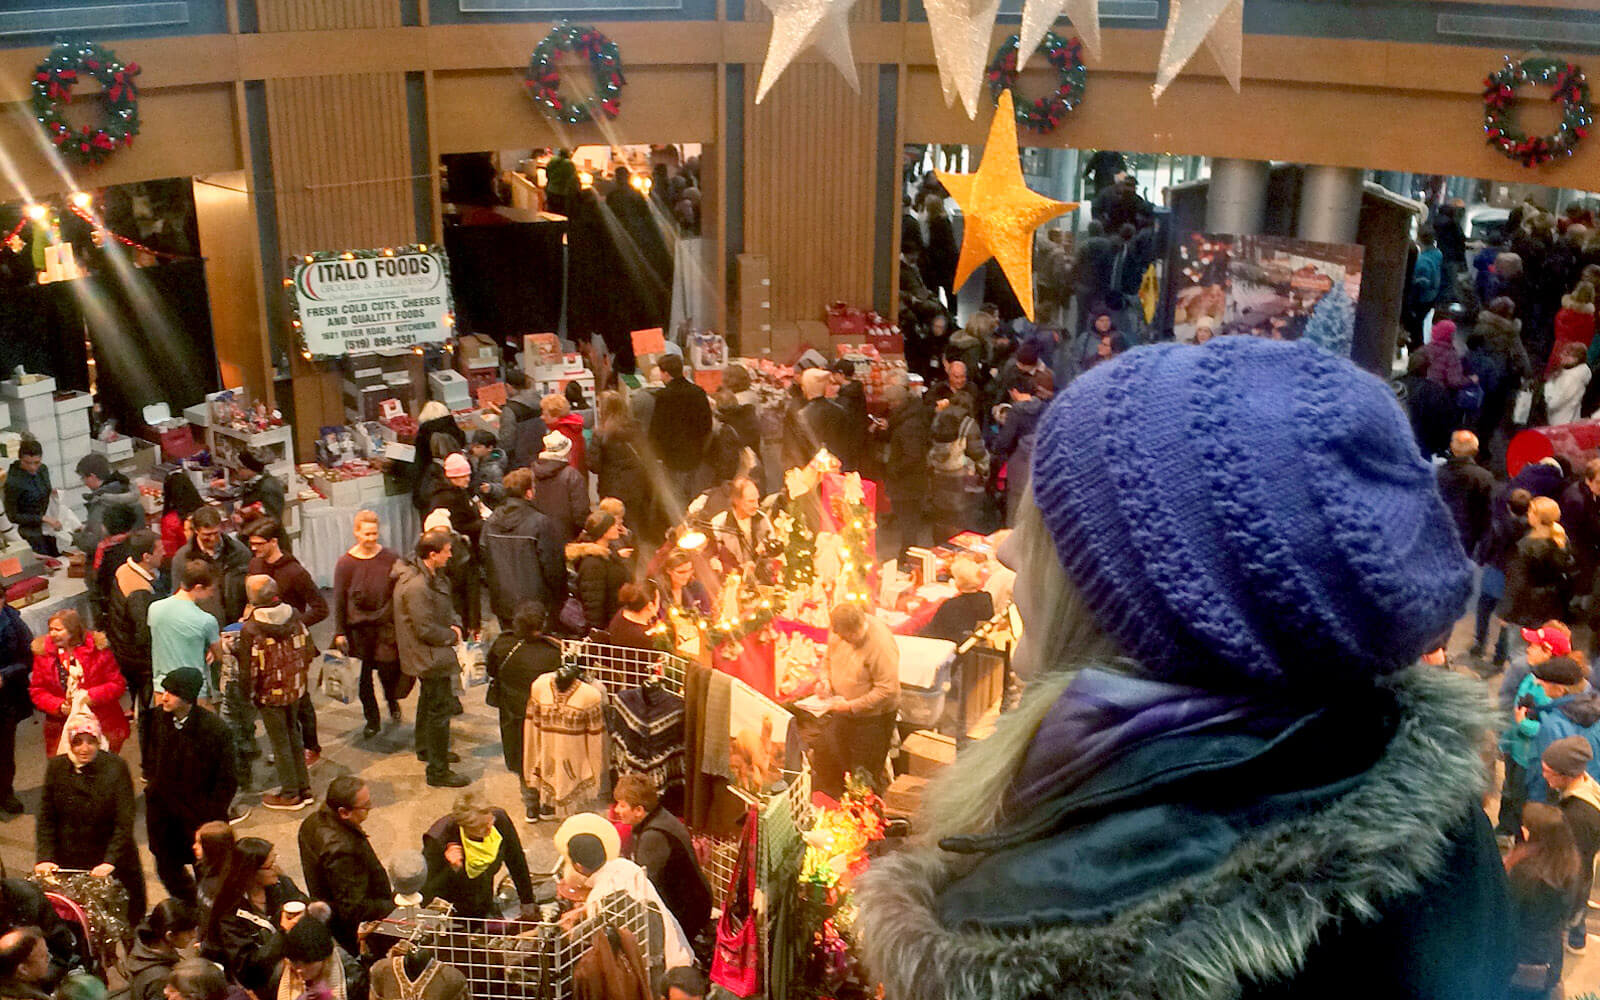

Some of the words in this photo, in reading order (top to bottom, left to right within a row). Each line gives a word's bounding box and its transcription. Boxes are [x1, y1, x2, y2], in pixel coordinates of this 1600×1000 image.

[318, 262, 368, 283] ITALO
[375, 257, 430, 278] FOODS
[306, 306, 338, 317] FRESH
[341, 303, 368, 314] COLD
[402, 297, 441, 308] CHEESES
[327, 316, 347, 327] AND
[351, 312, 392, 324] QUALITY
[396, 309, 425, 320] FOODS
[341, 328, 364, 338] RIVER
[366, 327, 386, 336] ROAD
[395, 321, 437, 332] KITCHENER
[344, 338, 370, 350] (519)
